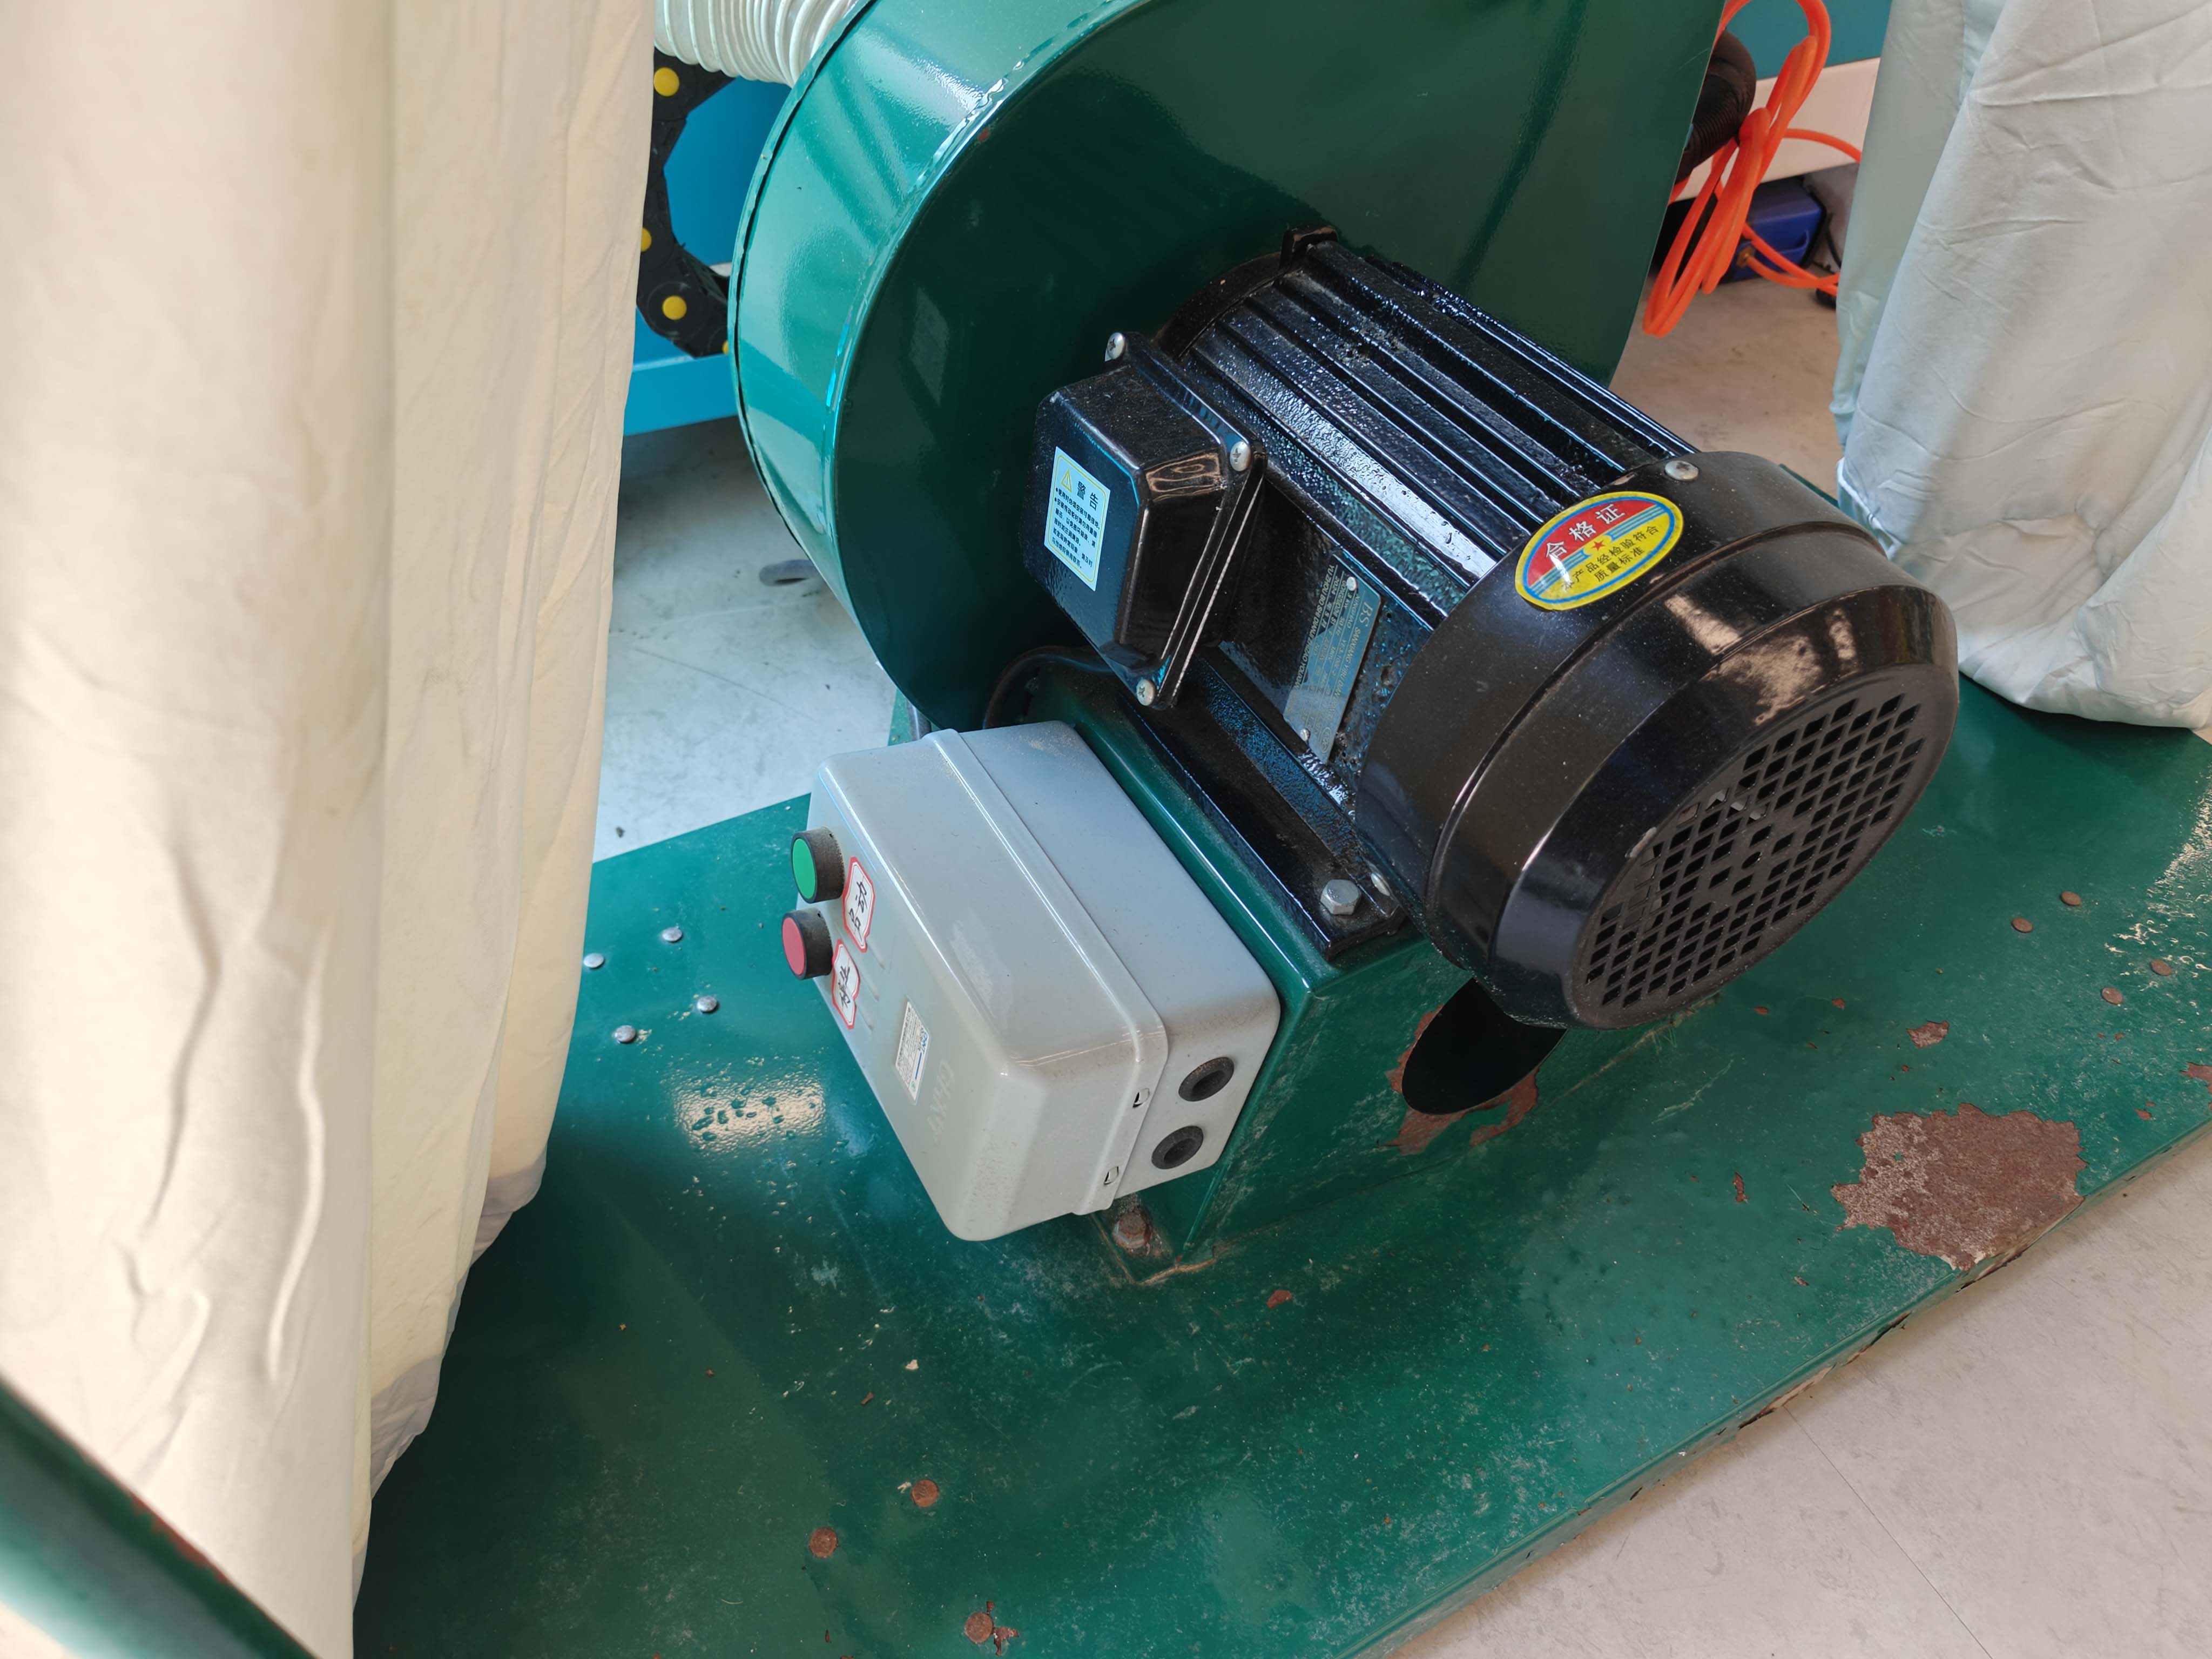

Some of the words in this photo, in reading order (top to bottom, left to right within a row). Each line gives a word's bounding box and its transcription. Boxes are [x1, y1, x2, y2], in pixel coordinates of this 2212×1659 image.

[1078, 481, 1098, 511] 警告
[1545, 503, 1625, 559] 合格证
[1594, 547, 1646, 582] 质量标准
[1359, 602, 1373, 627] BS
[1346, 627, 1360, 663] SANXIANG
